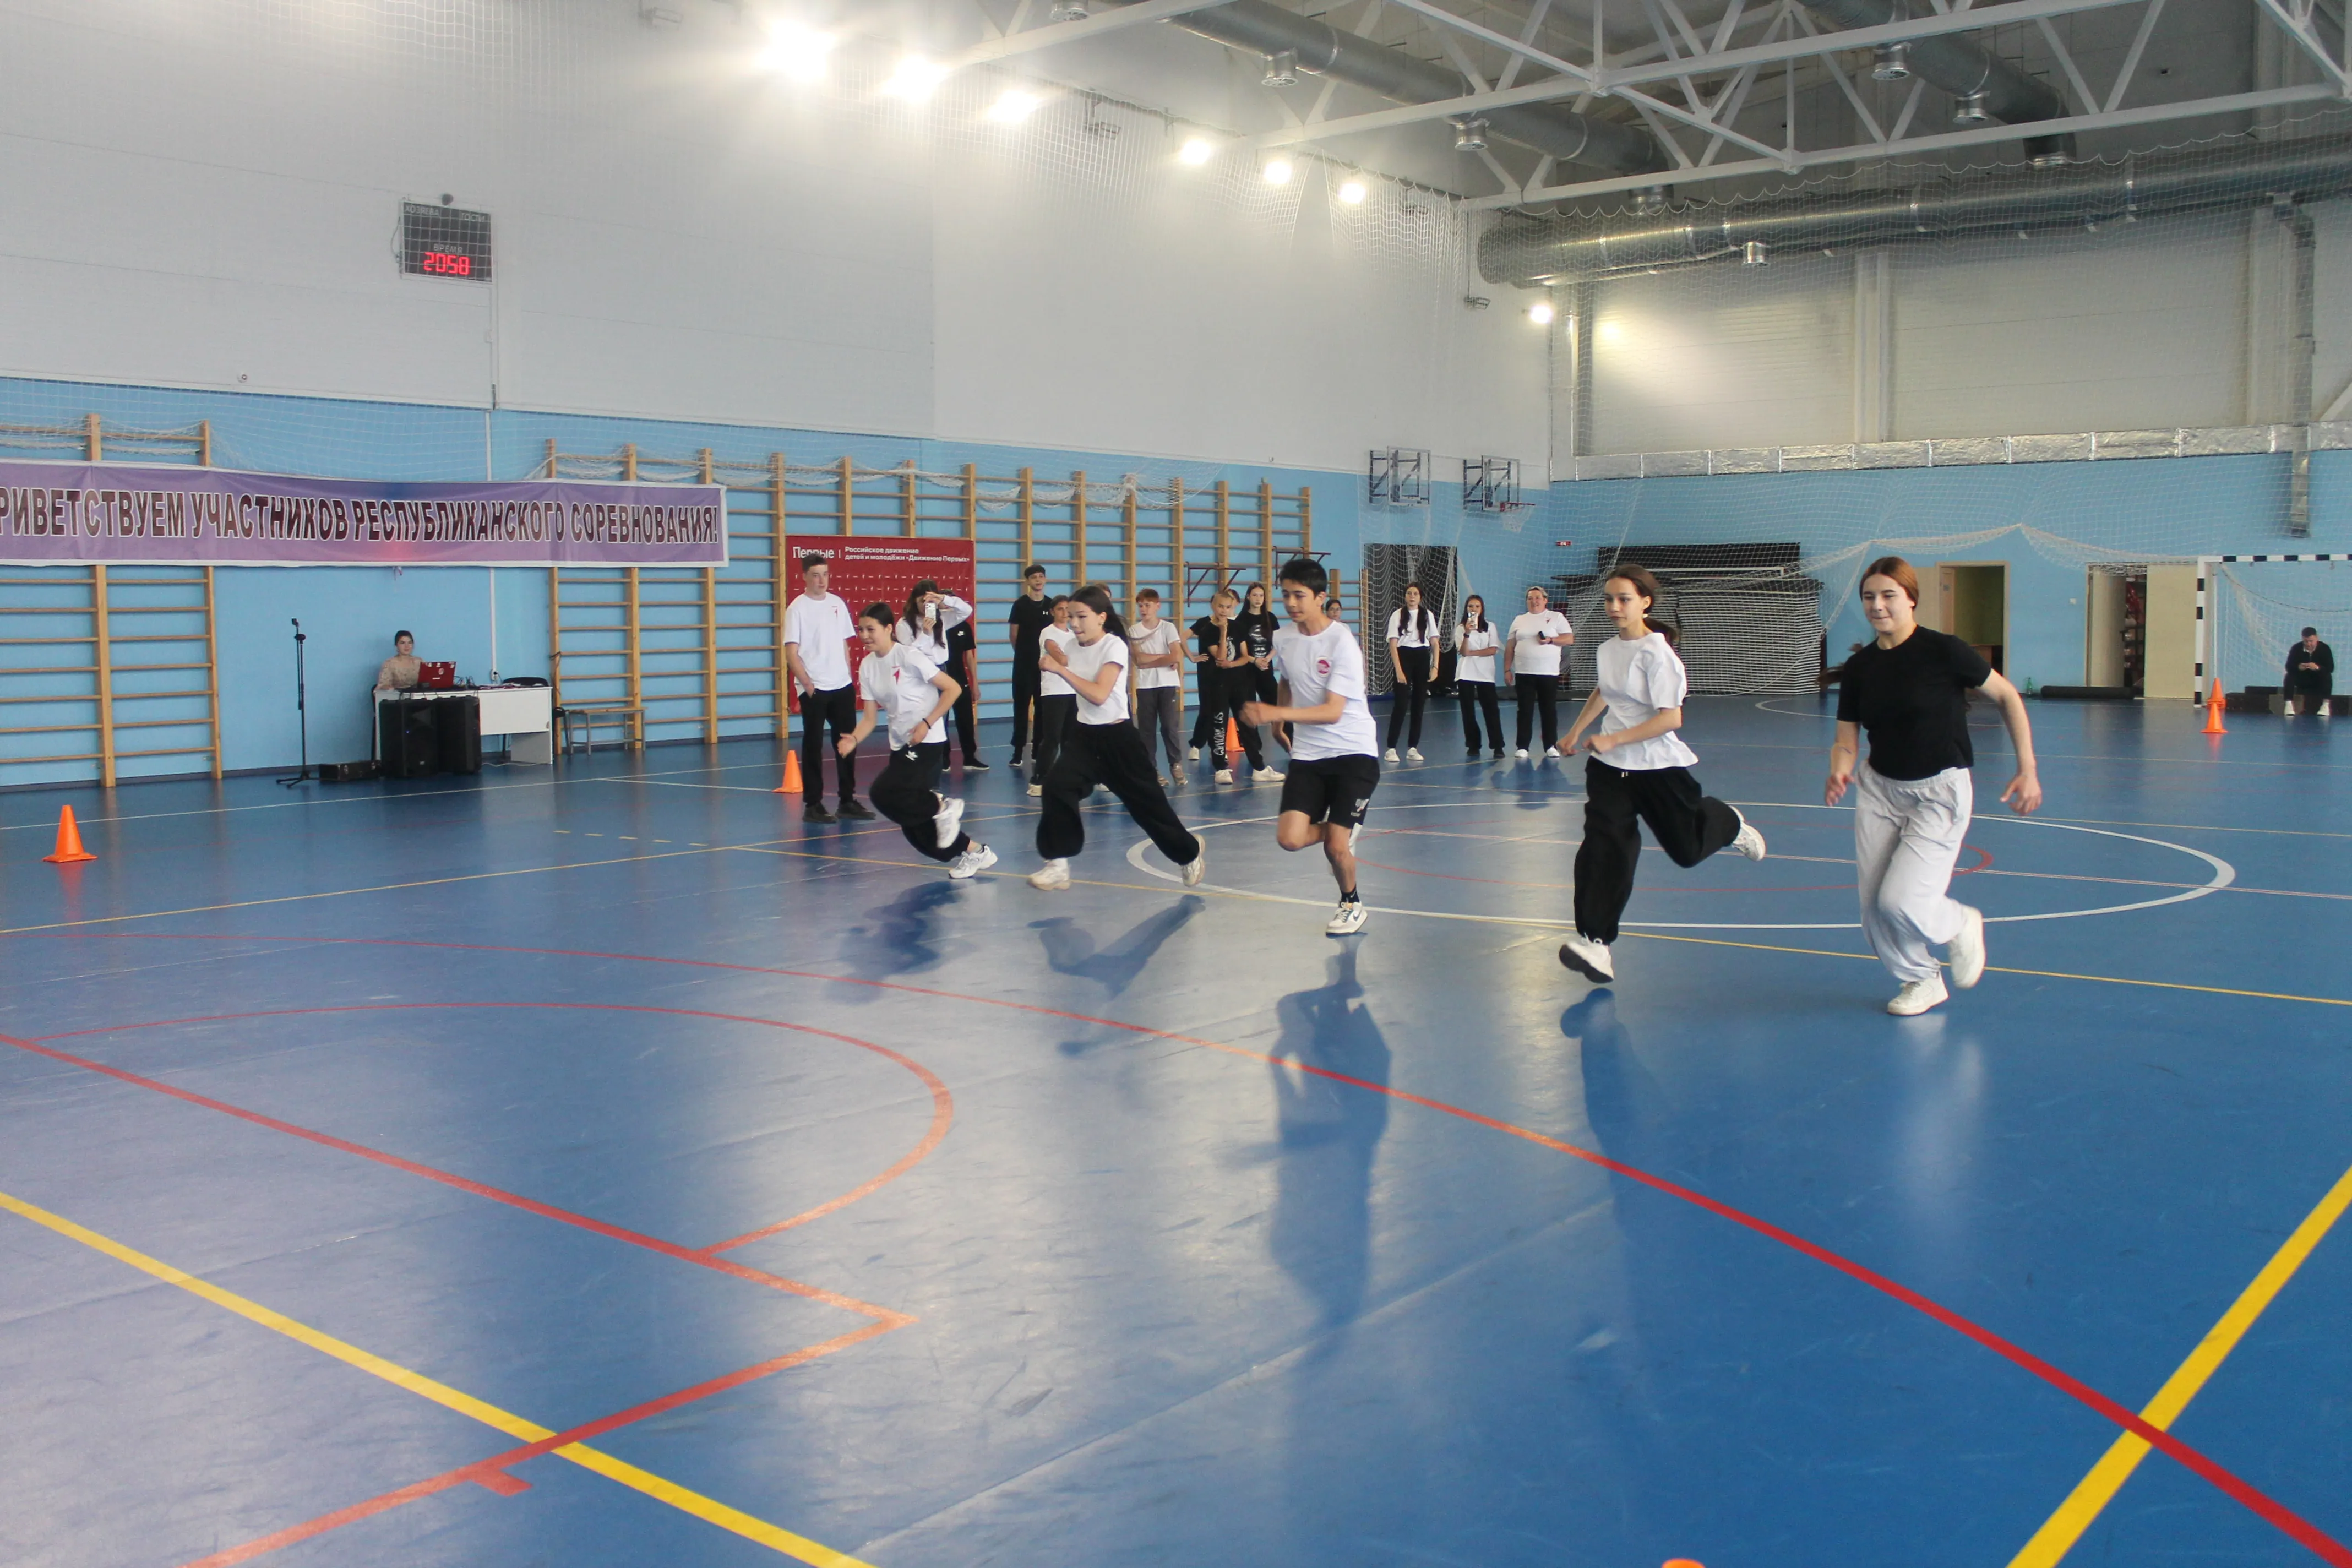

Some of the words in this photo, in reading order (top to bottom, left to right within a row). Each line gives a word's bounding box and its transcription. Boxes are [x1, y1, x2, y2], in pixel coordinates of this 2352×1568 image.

[405, 205, 440, 216] ХОЗЯЕВА
[461, 213, 485, 222] ГОСТИ
[433, 243, 463, 254] ВРЕМЯ
[423, 252, 470, 275] 2058
[0, 487, 186, 539] РИВЕТСТВУЕМ
[189, 492, 349, 541] УЧАСТНИКОВ
[350, 499, 566, 542] РЕСПУБЛИКАНСКОГО
[570, 502, 718, 544] СОРЕВНОВАНИЯ!
